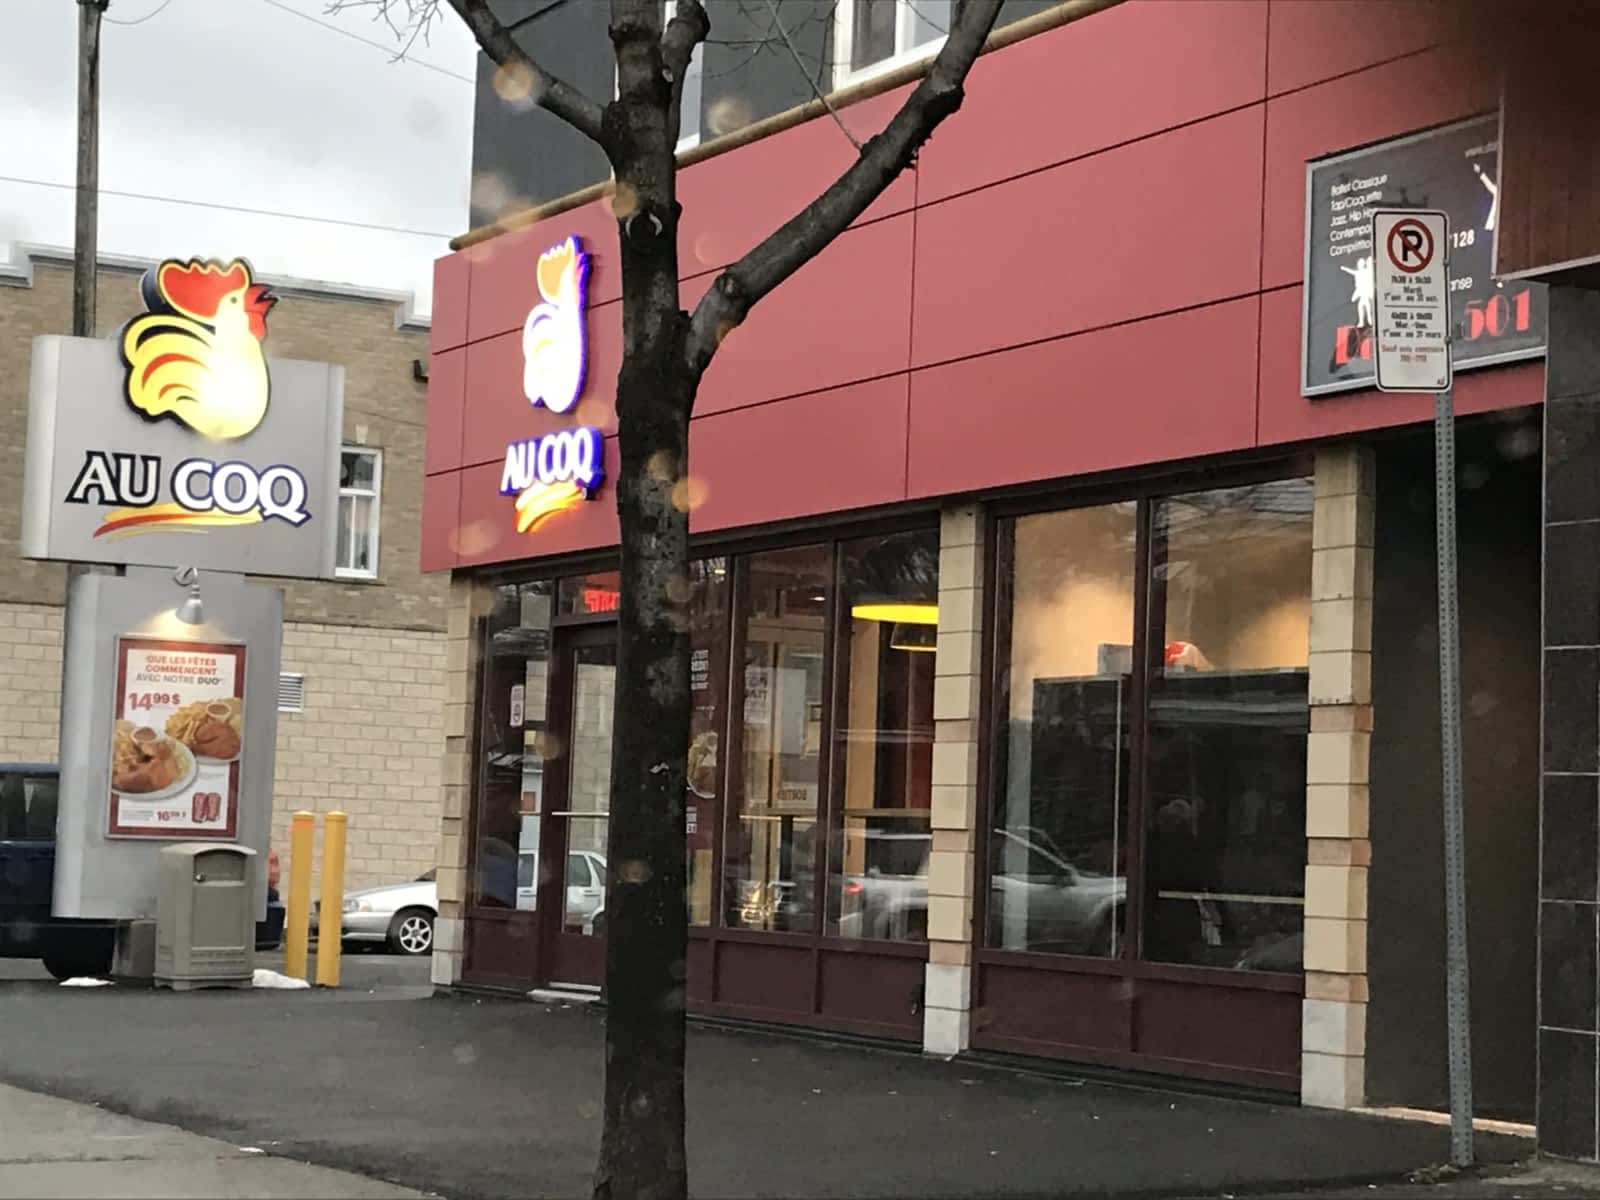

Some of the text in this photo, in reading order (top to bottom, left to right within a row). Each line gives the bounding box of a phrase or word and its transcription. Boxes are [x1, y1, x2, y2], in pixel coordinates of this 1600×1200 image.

[1352, 174, 1388, 191] Classique
[1349, 210, 1362, 222] Hip
[1330, 224, 1372, 241] Contempo
[1450, 228, 1475, 249] 128
[1463, 288, 1530, 342] 501
[501, 427, 604, 495] AU COQ
[64, 450, 312, 528] AU COQ
[146, 655, 217, 667] QUE LES FÊTES
[145, 664, 218, 676] COMMENCENT
[136, 673, 161, 683] AVEC
[163, 674, 194, 685] NOTRE
